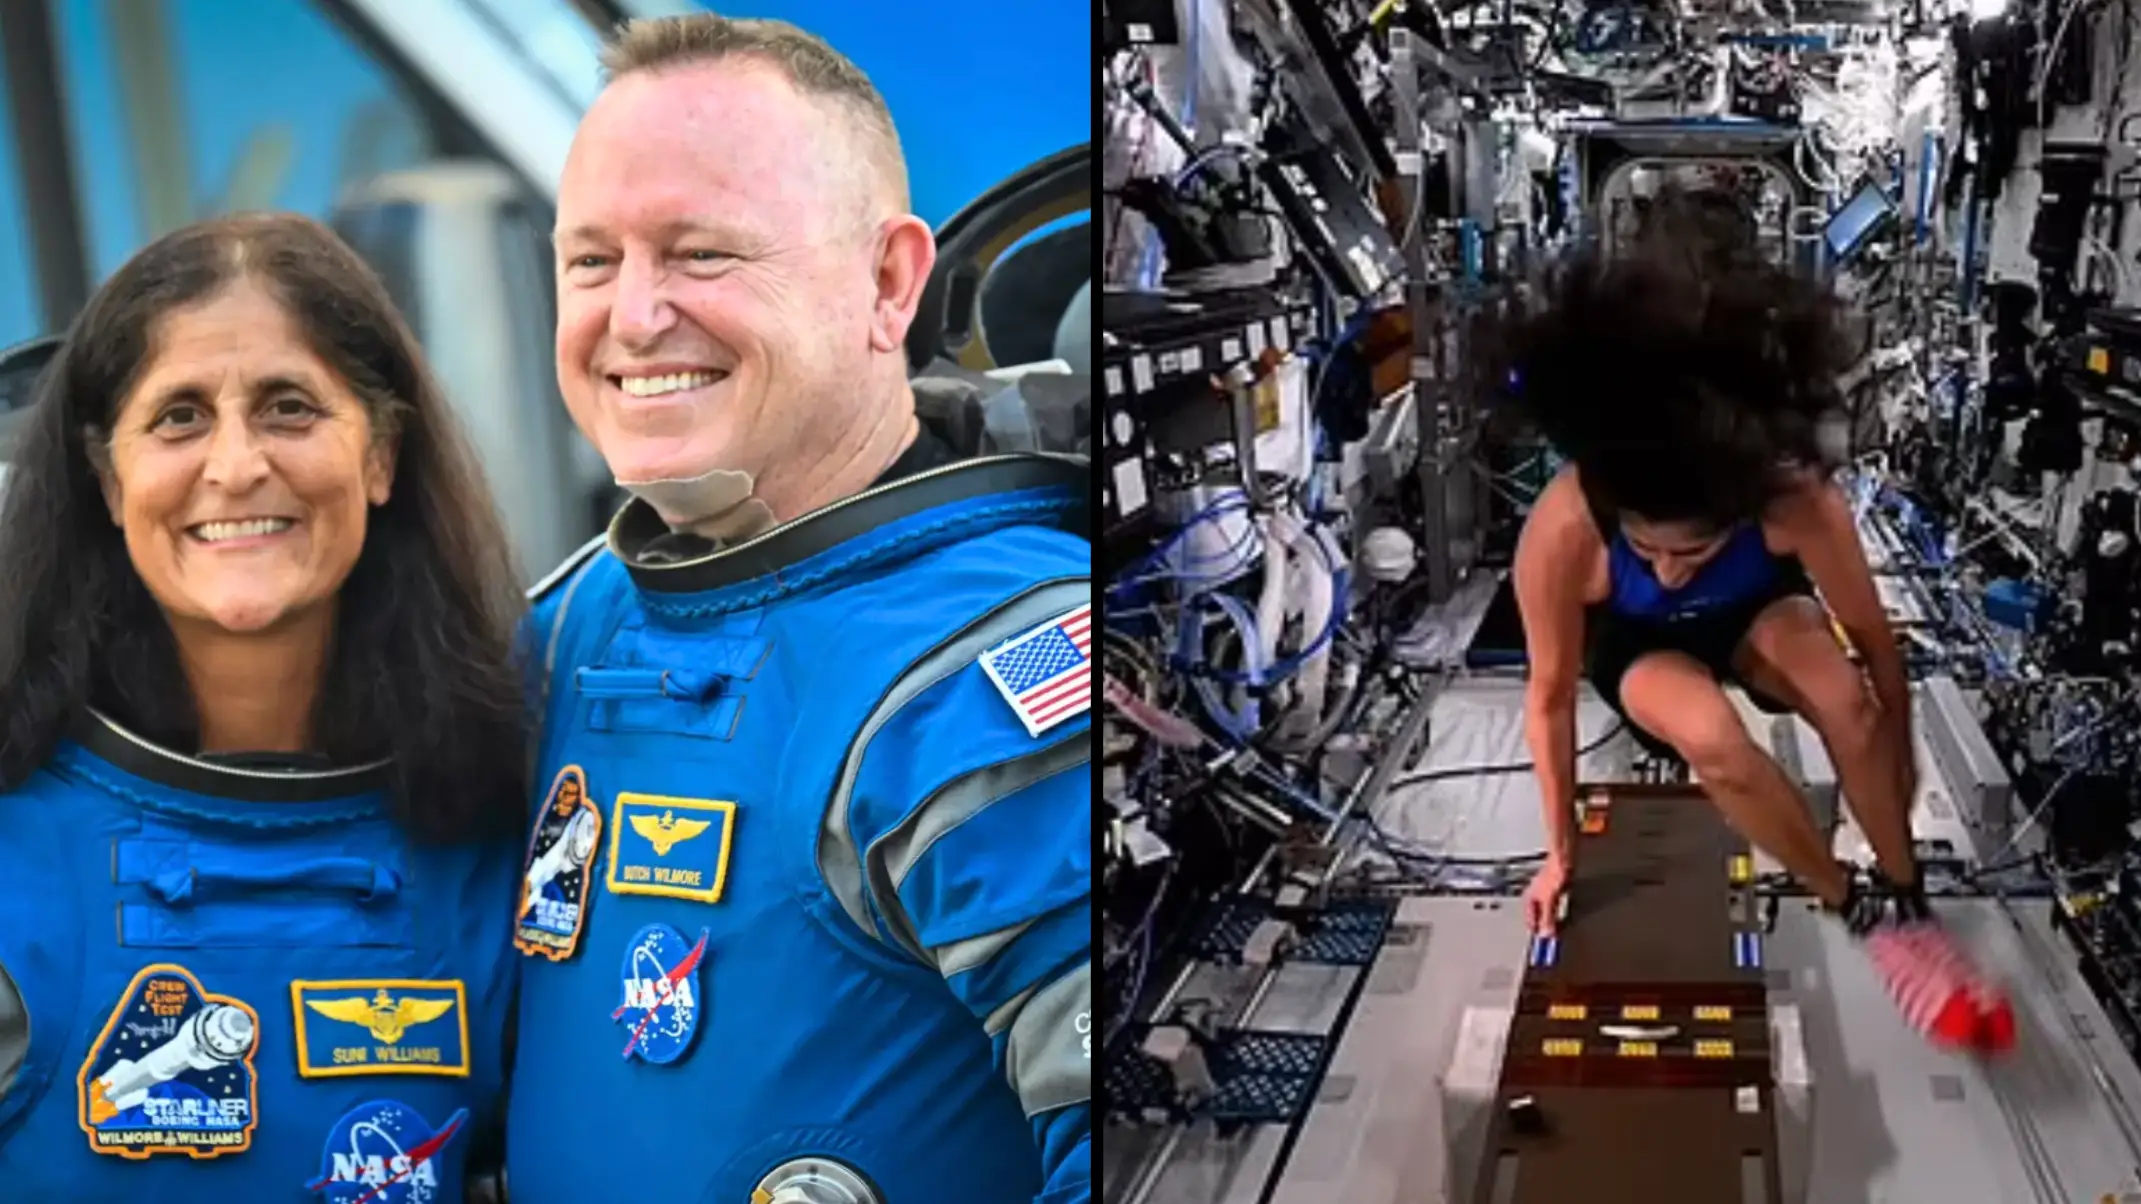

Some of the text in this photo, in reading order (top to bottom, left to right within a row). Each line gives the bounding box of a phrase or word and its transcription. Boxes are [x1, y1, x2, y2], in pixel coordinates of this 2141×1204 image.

[654, 867, 702, 886] WILMORE
[624, 976, 695, 1009] NASA
[151, 1003, 184, 1017] TEST
[333, 1046, 441, 1063] SUNI WILLIAMS
[143, 1097, 249, 1117] STARLINER
[151, 1116, 240, 1126] BOEING NASA
[98, 1131, 243, 1144] WILMORE WILLIAMS
[330, 1152, 438, 1187] NASA
